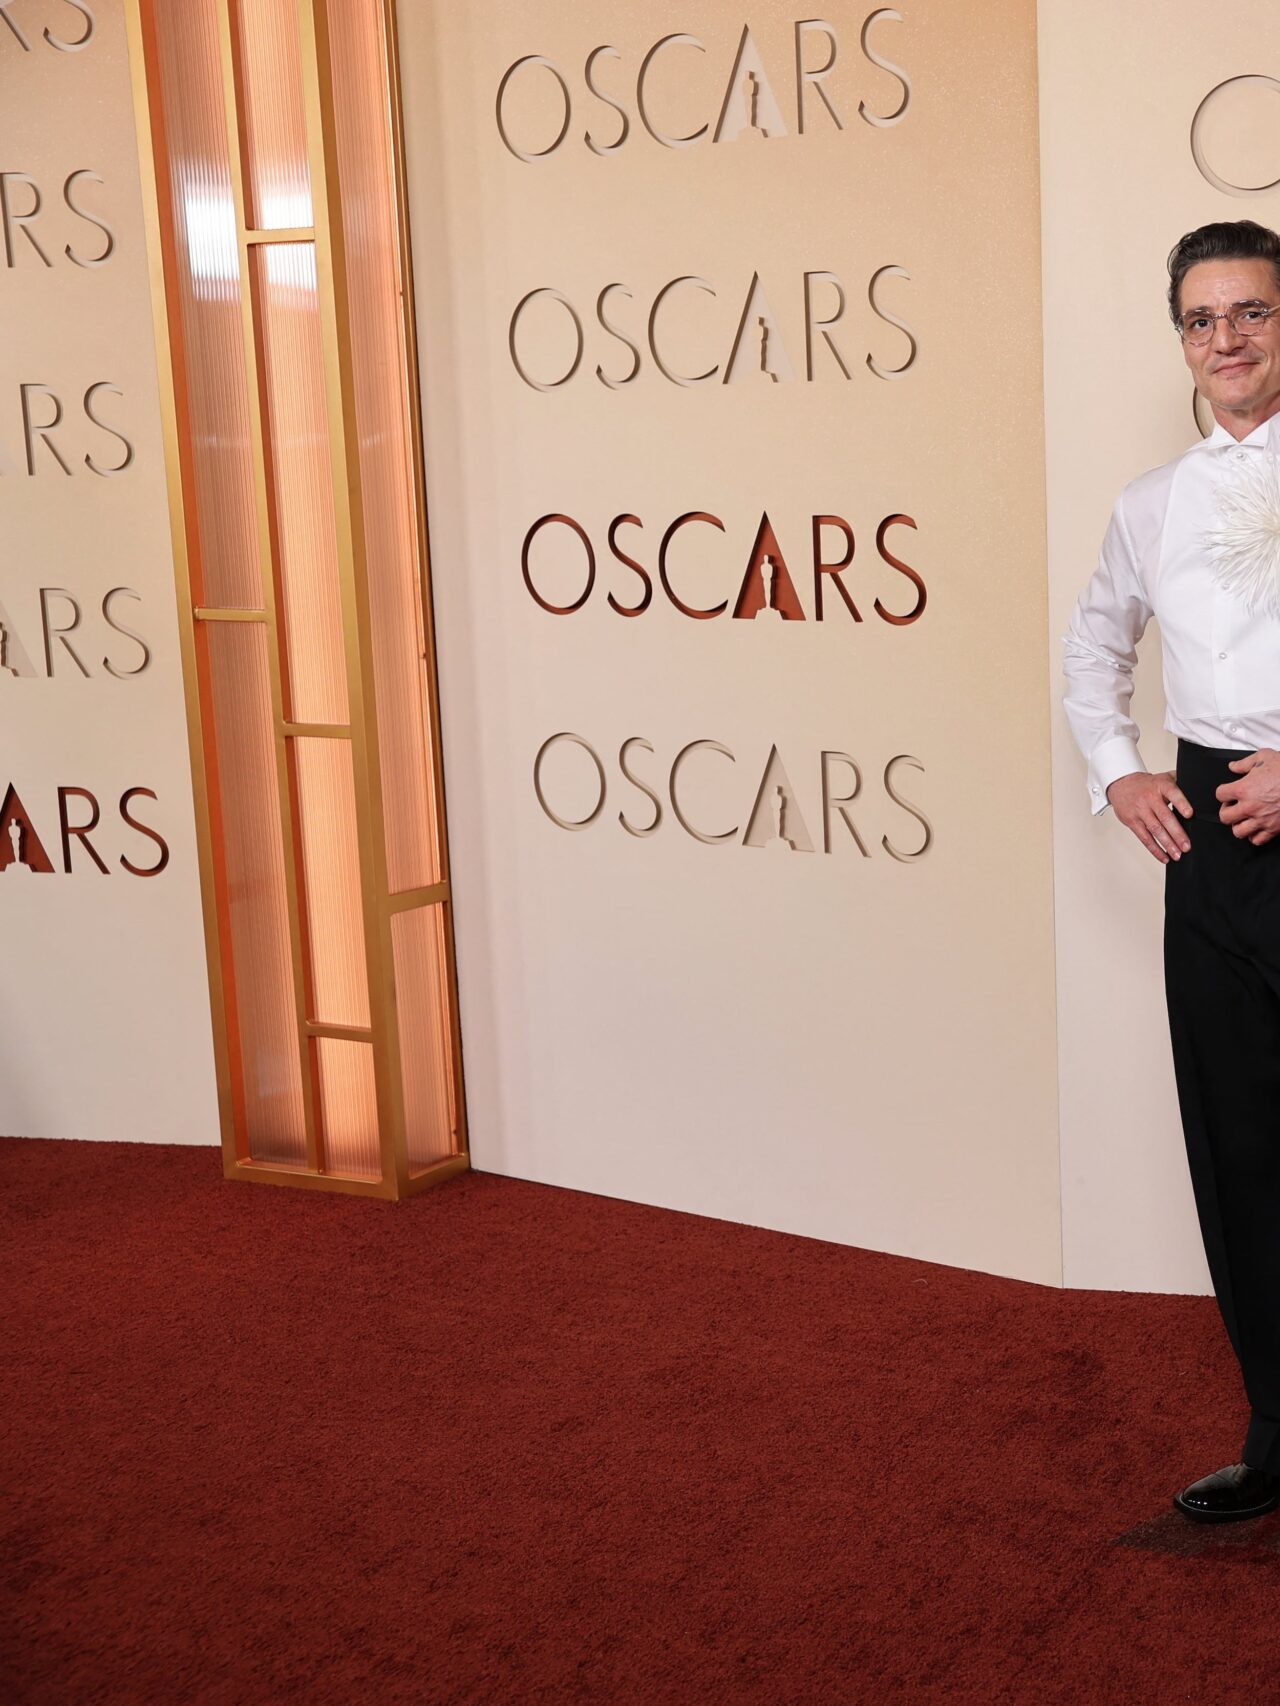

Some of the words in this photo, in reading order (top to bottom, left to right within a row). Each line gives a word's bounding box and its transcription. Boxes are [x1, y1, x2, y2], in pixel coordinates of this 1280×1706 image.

[496, 7, 913, 163] OSCARS
[509, 264, 920, 393] OSCARS
[0, 381, 135, 478] RS
[521, 510, 928, 626] OSCARS
[533, 732, 934, 864] OSCARS
